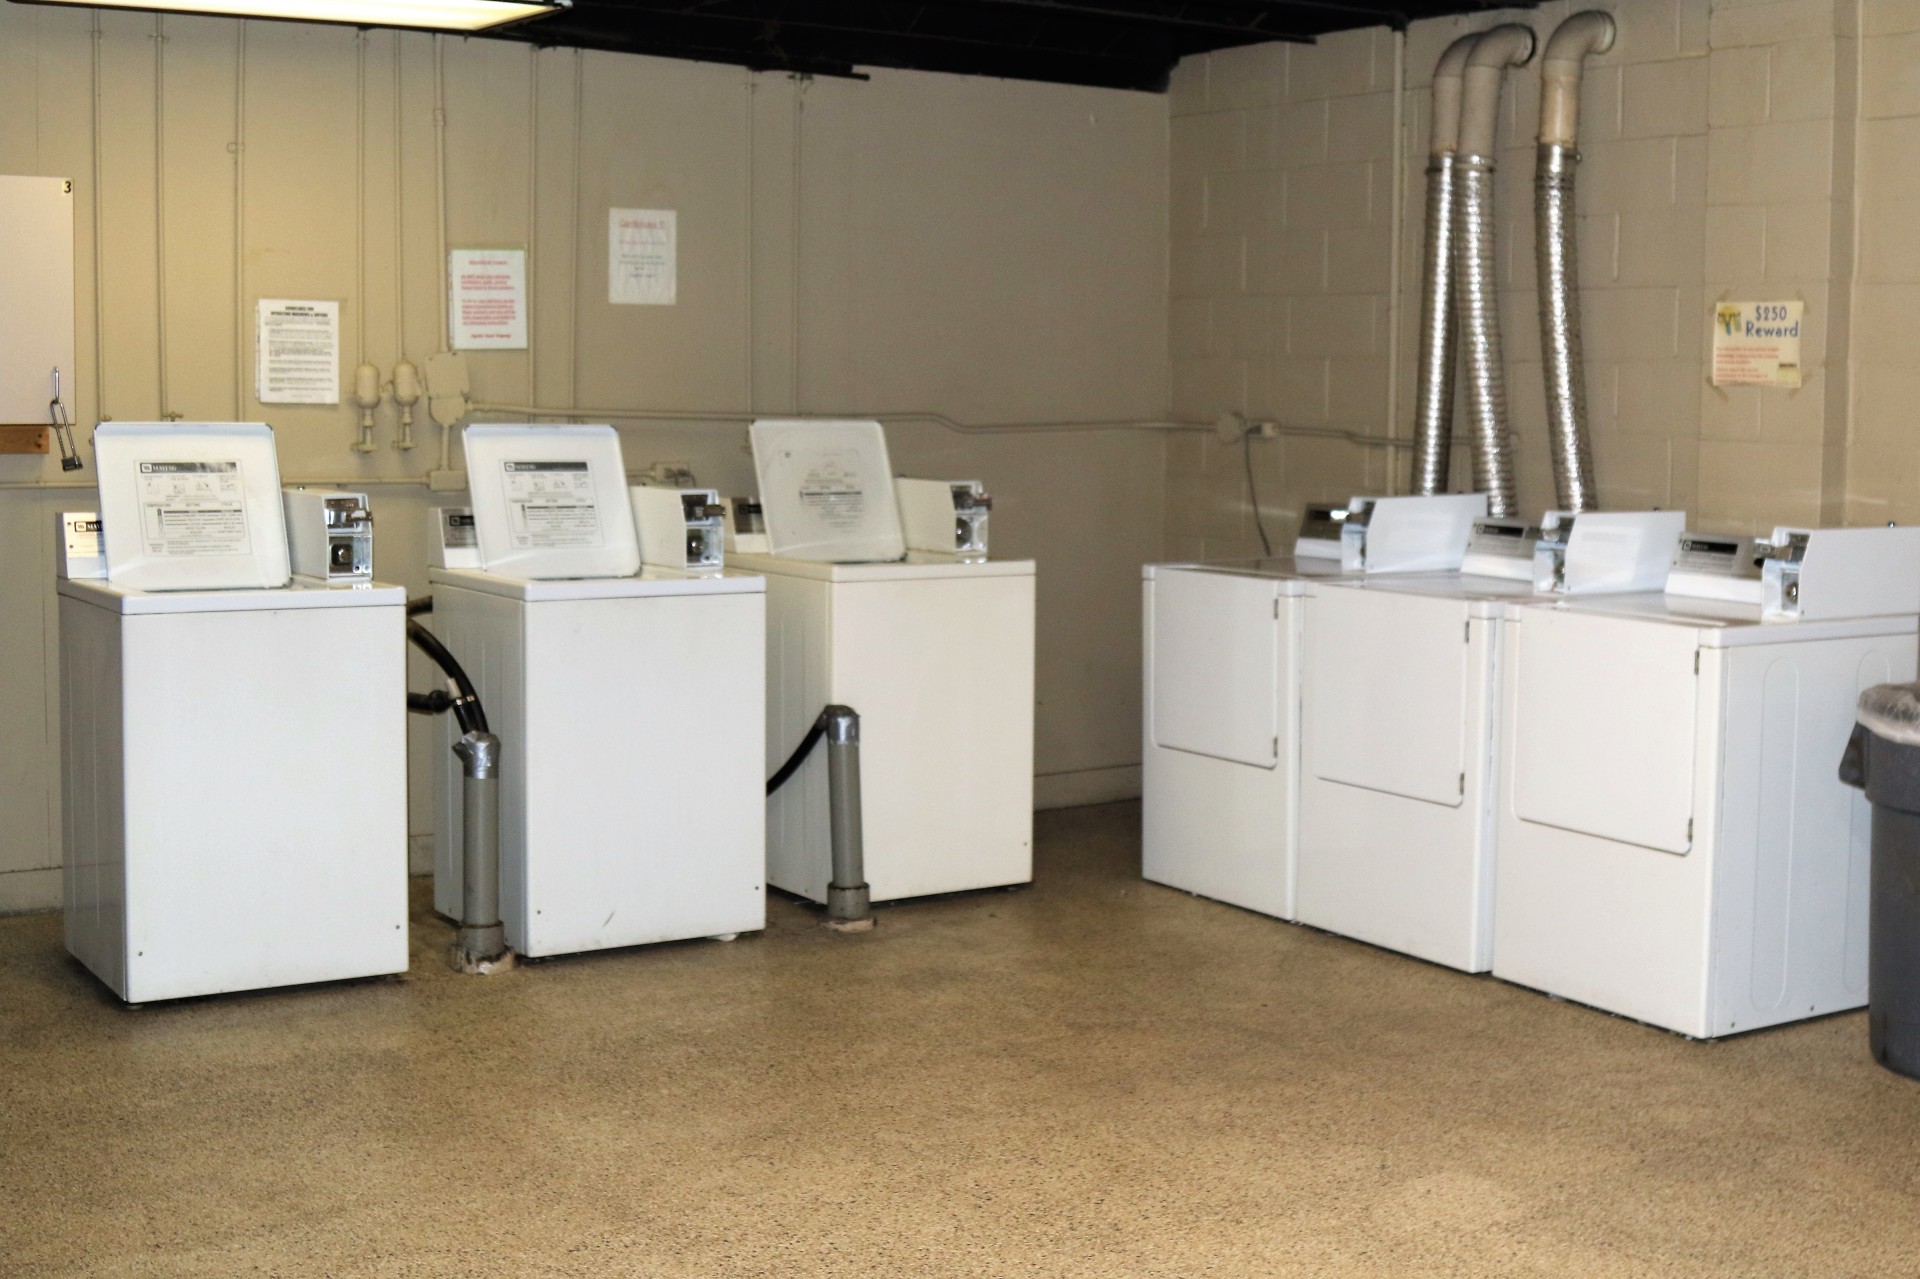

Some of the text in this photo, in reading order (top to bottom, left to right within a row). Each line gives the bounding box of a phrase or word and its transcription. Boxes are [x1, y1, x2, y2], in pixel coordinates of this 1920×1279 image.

[64, 180, 72, 193] 3
[1756, 305, 1787, 322] $250
[1746, 320, 1798, 337] Reward
